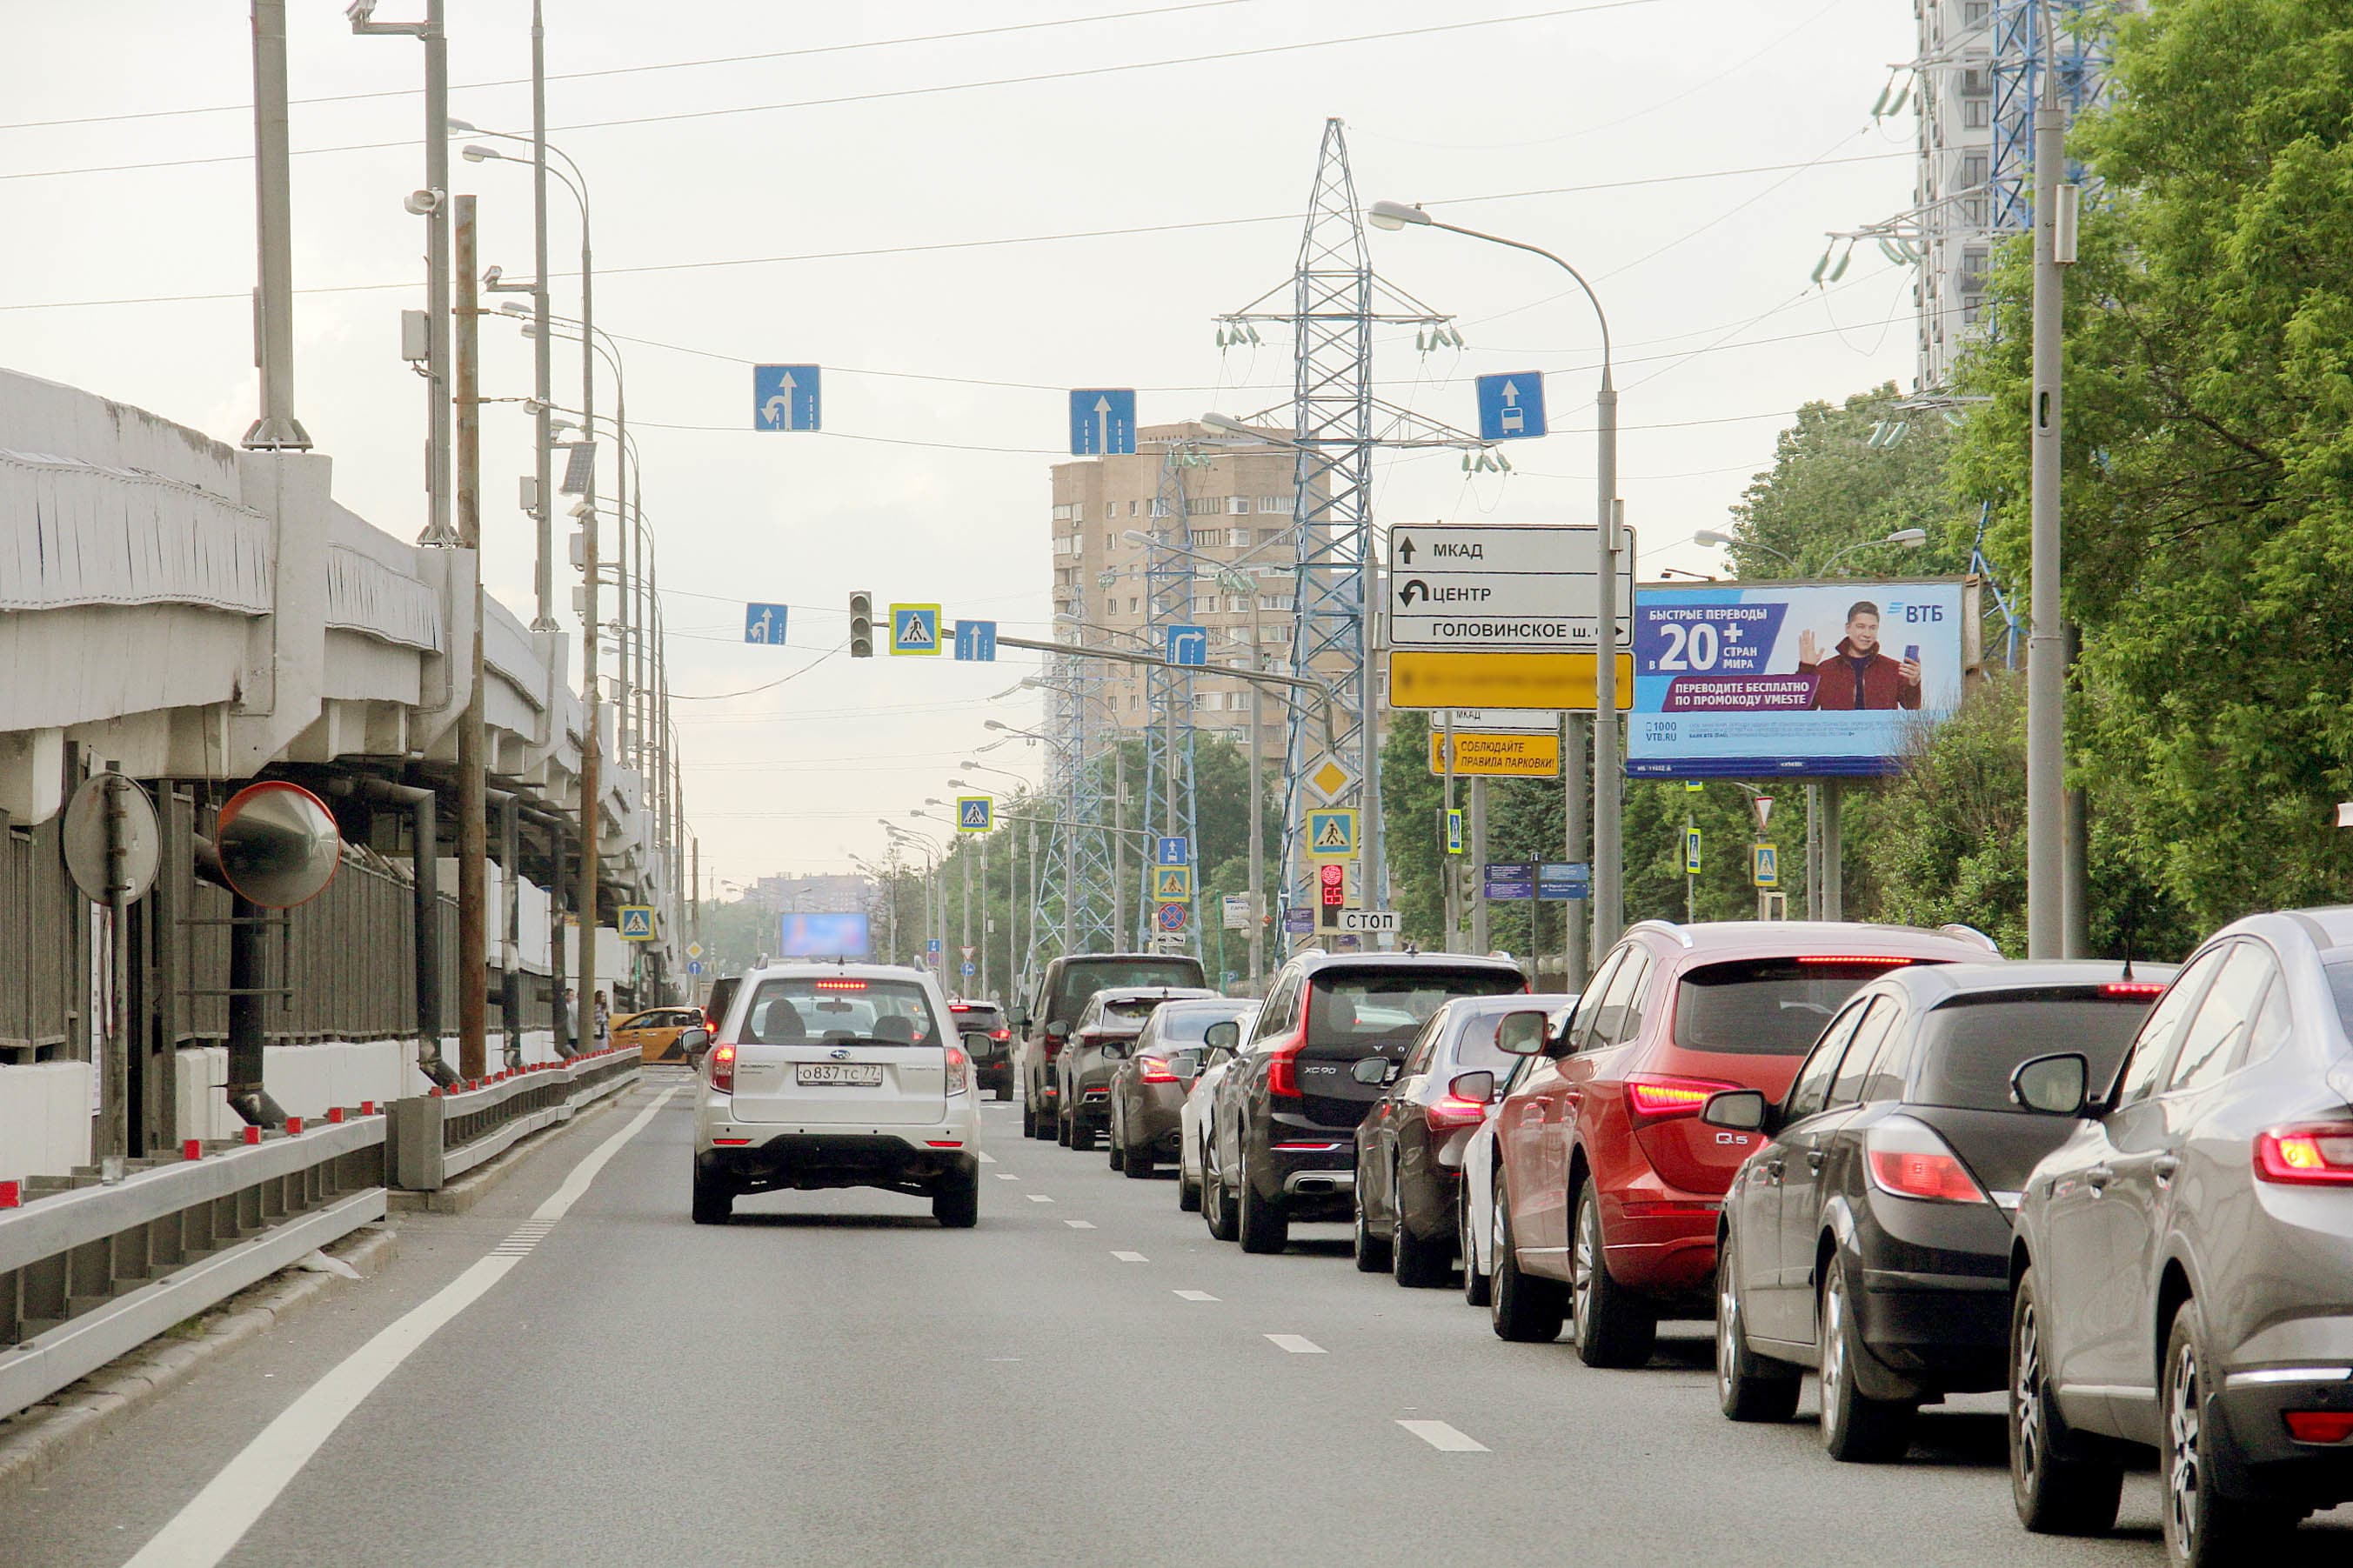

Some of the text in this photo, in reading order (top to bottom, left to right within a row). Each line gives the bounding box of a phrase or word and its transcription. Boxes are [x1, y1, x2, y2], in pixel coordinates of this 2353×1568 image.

[1434, 543, 1483, 559] МКАД
[1434, 587, 1491, 603] ЦЕНТР
[1649, 609, 1767, 621] БЫСТРЫЕ ПЕРЕВОДЫ
[1906, 605, 1943, 623] ВТБ
[1434, 624, 1590, 637] ГОЛОВИНСКОЕ ш.
[1723, 648, 1757, 657] СТРАН
[1723, 659, 1754, 669] МИРА
[1675, 682, 1809, 693] ПЕРЕВОДИТЕ БЕСПЛАТНО
[1675, 695, 1807, 706] ПО ПРОМОКОДУ VMESTE
[1654, 722, 1677, 731] 1000
[1646, 733, 1677, 742] VTB.RU
[1461, 740, 1525, 754] СОБЛЮДАЙТЕ
[1461, 757, 1554, 769] ПРАВИЛА ПАРКОВКИ!
[1347, 914, 1394, 929] СТОП
[863, 1065, 877, 1078] 77
[1716, 1132, 1748, 1144] Q5
